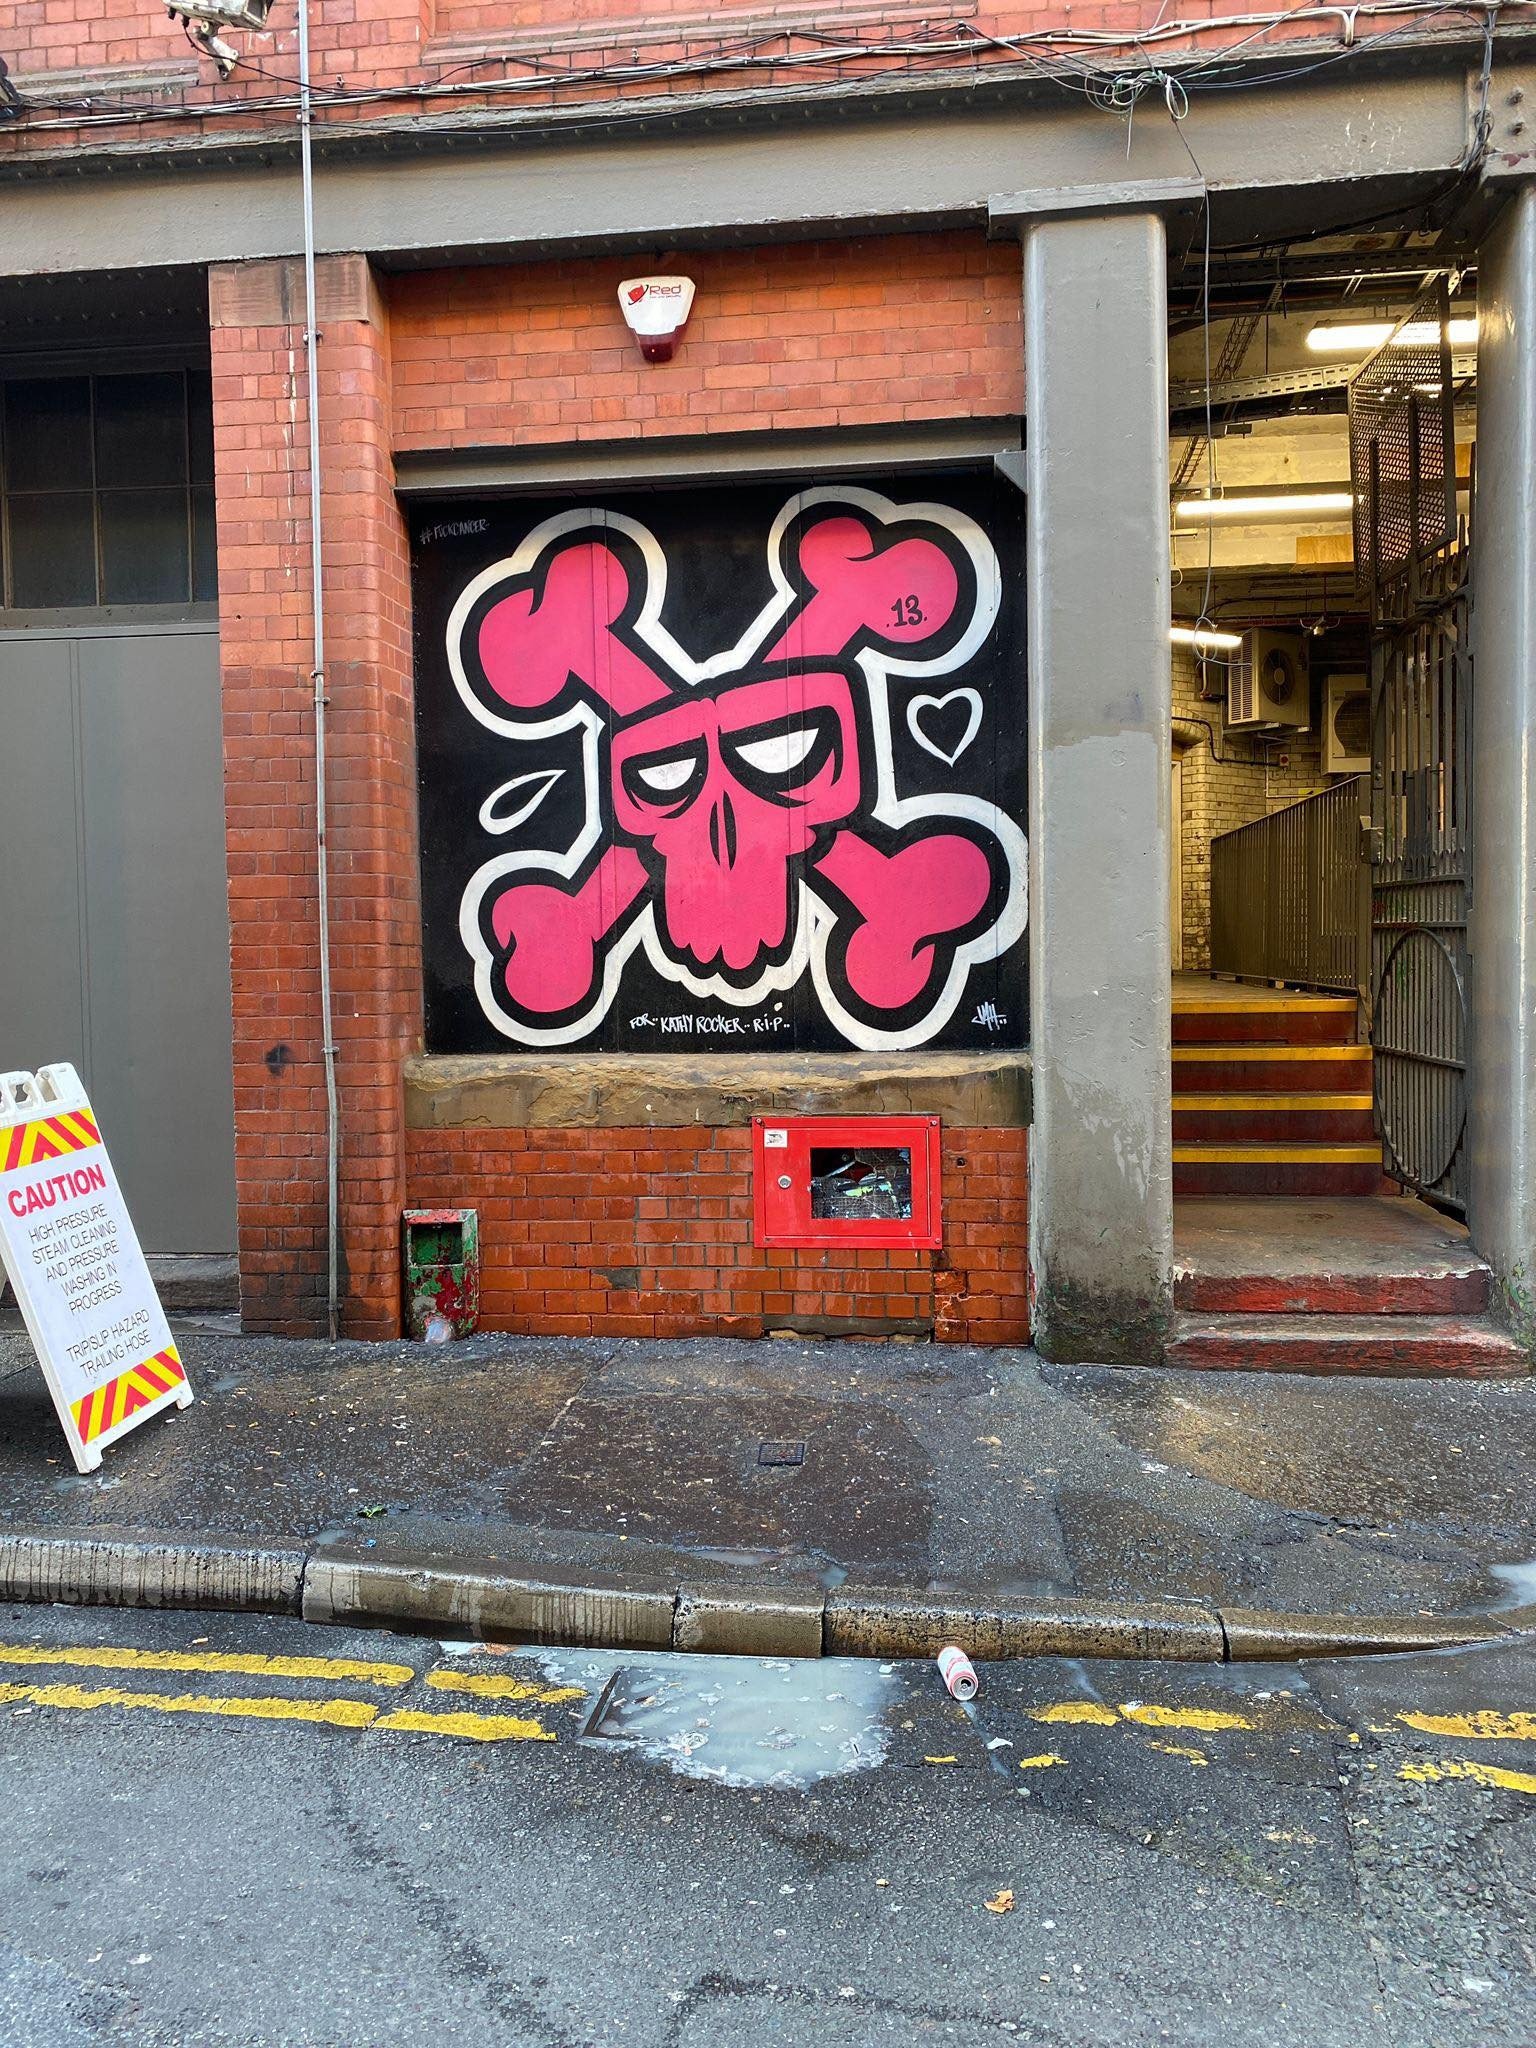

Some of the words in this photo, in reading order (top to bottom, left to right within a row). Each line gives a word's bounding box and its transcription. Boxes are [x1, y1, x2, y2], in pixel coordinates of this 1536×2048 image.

[650, 284, 682, 296] Red
[661, 1014, 693, 1034] KATHY
[7, 1163, 106, 1218] CAUTION
[28, 1222, 56, 1244] HIGH
[55, 1203, 108, 1234] PRESSURE
[32, 1238, 70, 1265] STEAM
[70, 1220, 117, 1249] CLEANING
[46, 1261, 68, 1283] AND
[68, 1239, 119, 1272] PRESSURE
[61, 1266, 106, 1297] WASHING
[106, 1261, 118, 1277] IN
[69, 1280, 122, 1316] PROGRESS
[66, 1329, 109, 1362] TRIP/SLIP
[110, 1309, 150, 1340] HAZARD
[80, 1343, 125, 1378] TRAILING
[124, 1329, 151, 1354] HOSE
